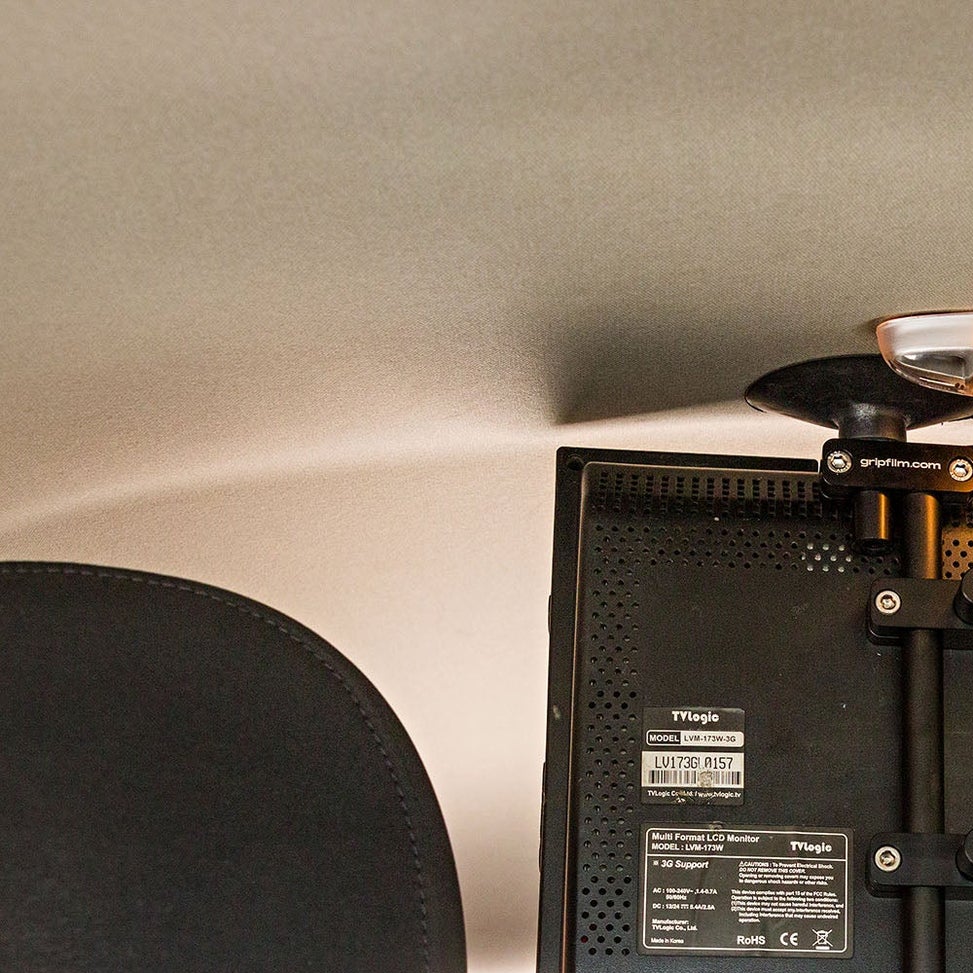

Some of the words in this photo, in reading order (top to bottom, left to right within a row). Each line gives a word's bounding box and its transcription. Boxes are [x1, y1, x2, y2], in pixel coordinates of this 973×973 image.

[860, 458, 941, 469] gripfilm.com
[652, 833, 673, 841] Multi
[675, 860, 709, 869] Support
[737, 936, 766, 945] RoHS
